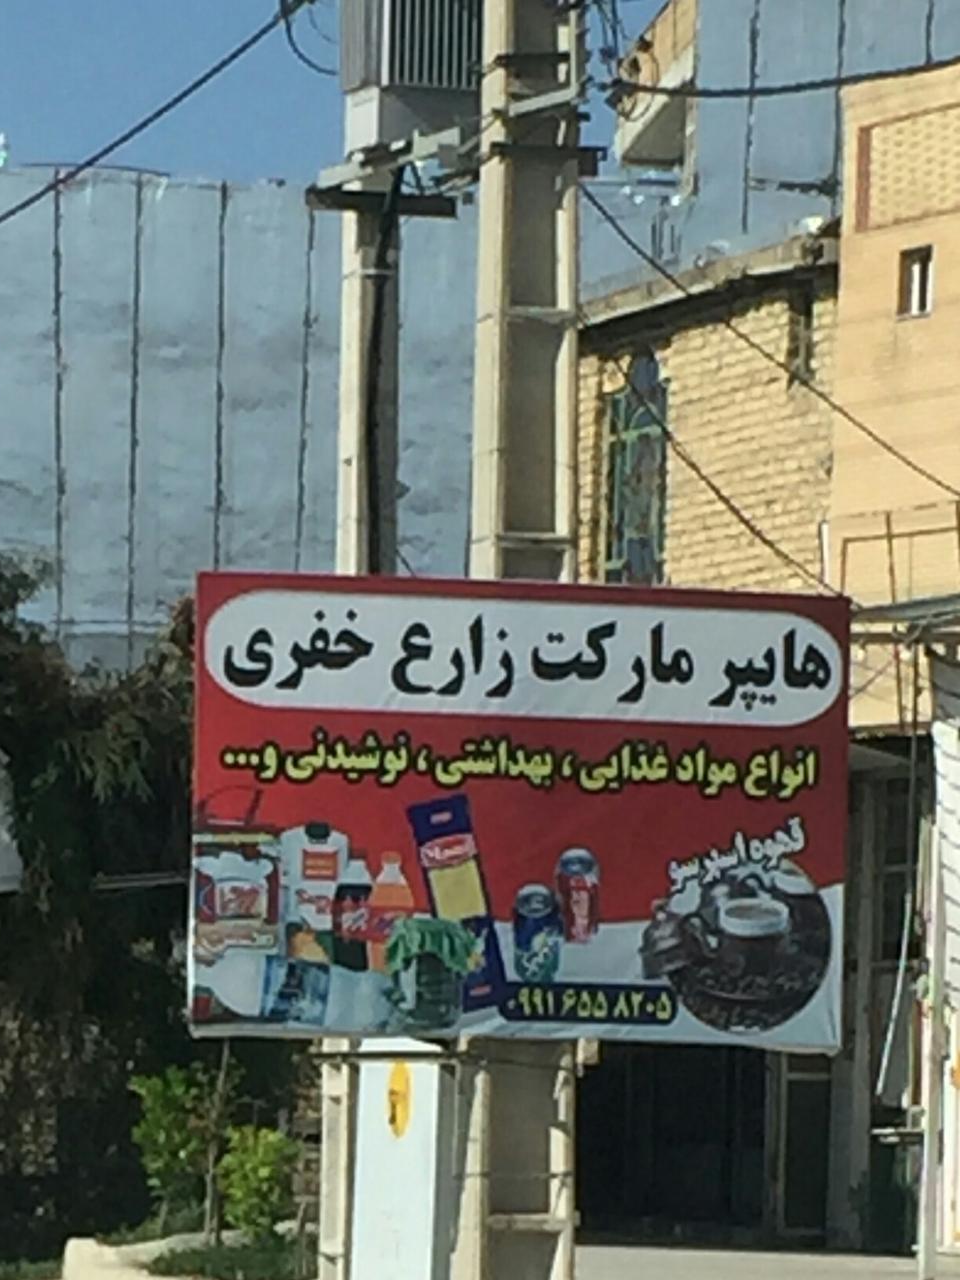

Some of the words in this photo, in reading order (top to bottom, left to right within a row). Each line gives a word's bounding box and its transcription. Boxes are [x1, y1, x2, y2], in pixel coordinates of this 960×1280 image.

[223, 608, 374, 690] خفری
[392, 613, 515, 698] زارع
[531, 621, 695, 703] مارکت
[708, 628, 832, 711] هایپر
[285, 729, 410, 784] نوشیدنی
[675, 746, 737, 796] مواد
[743, 748, 817, 798] انواع
[748, 815, 806, 869] قهوه
